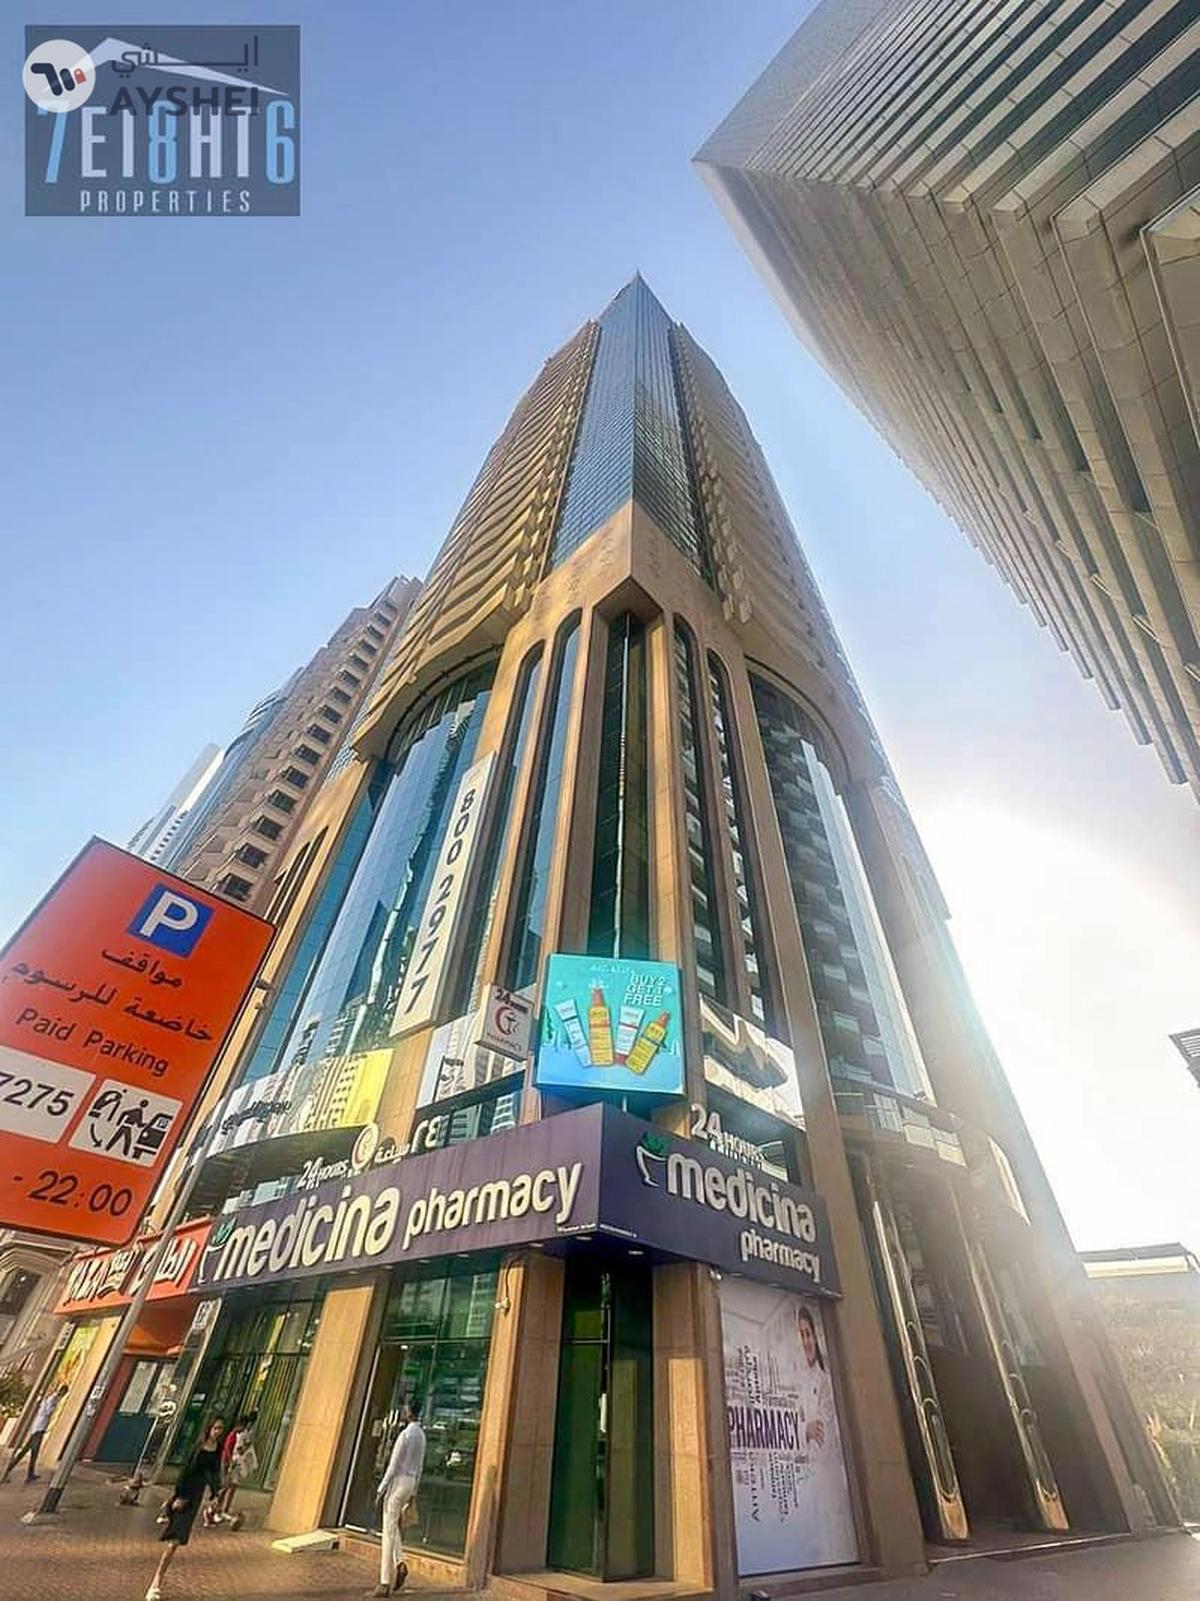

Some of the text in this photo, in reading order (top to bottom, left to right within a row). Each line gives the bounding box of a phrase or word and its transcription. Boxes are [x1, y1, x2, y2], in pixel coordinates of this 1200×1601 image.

[140, 890, 199, 938] P
[102, 949, 182, 988] مواقف
[2, 962, 213, 1041] خاضعة للرسوم
[623, 992, 664, 1007] FREE
[15, 1008, 169, 1078] Paid Parking
[690, 1103, 722, 1149] 24
[28, 1171, 133, 1216] 22:00
[667, 1152, 817, 1243] medicina
[213, 1185, 401, 1282] medicina
[402, 1162, 583, 1251] pharmacy
[740, 1228, 821, 1284] pharmacy
[727, 1405, 800, 1450] PHARMACY
